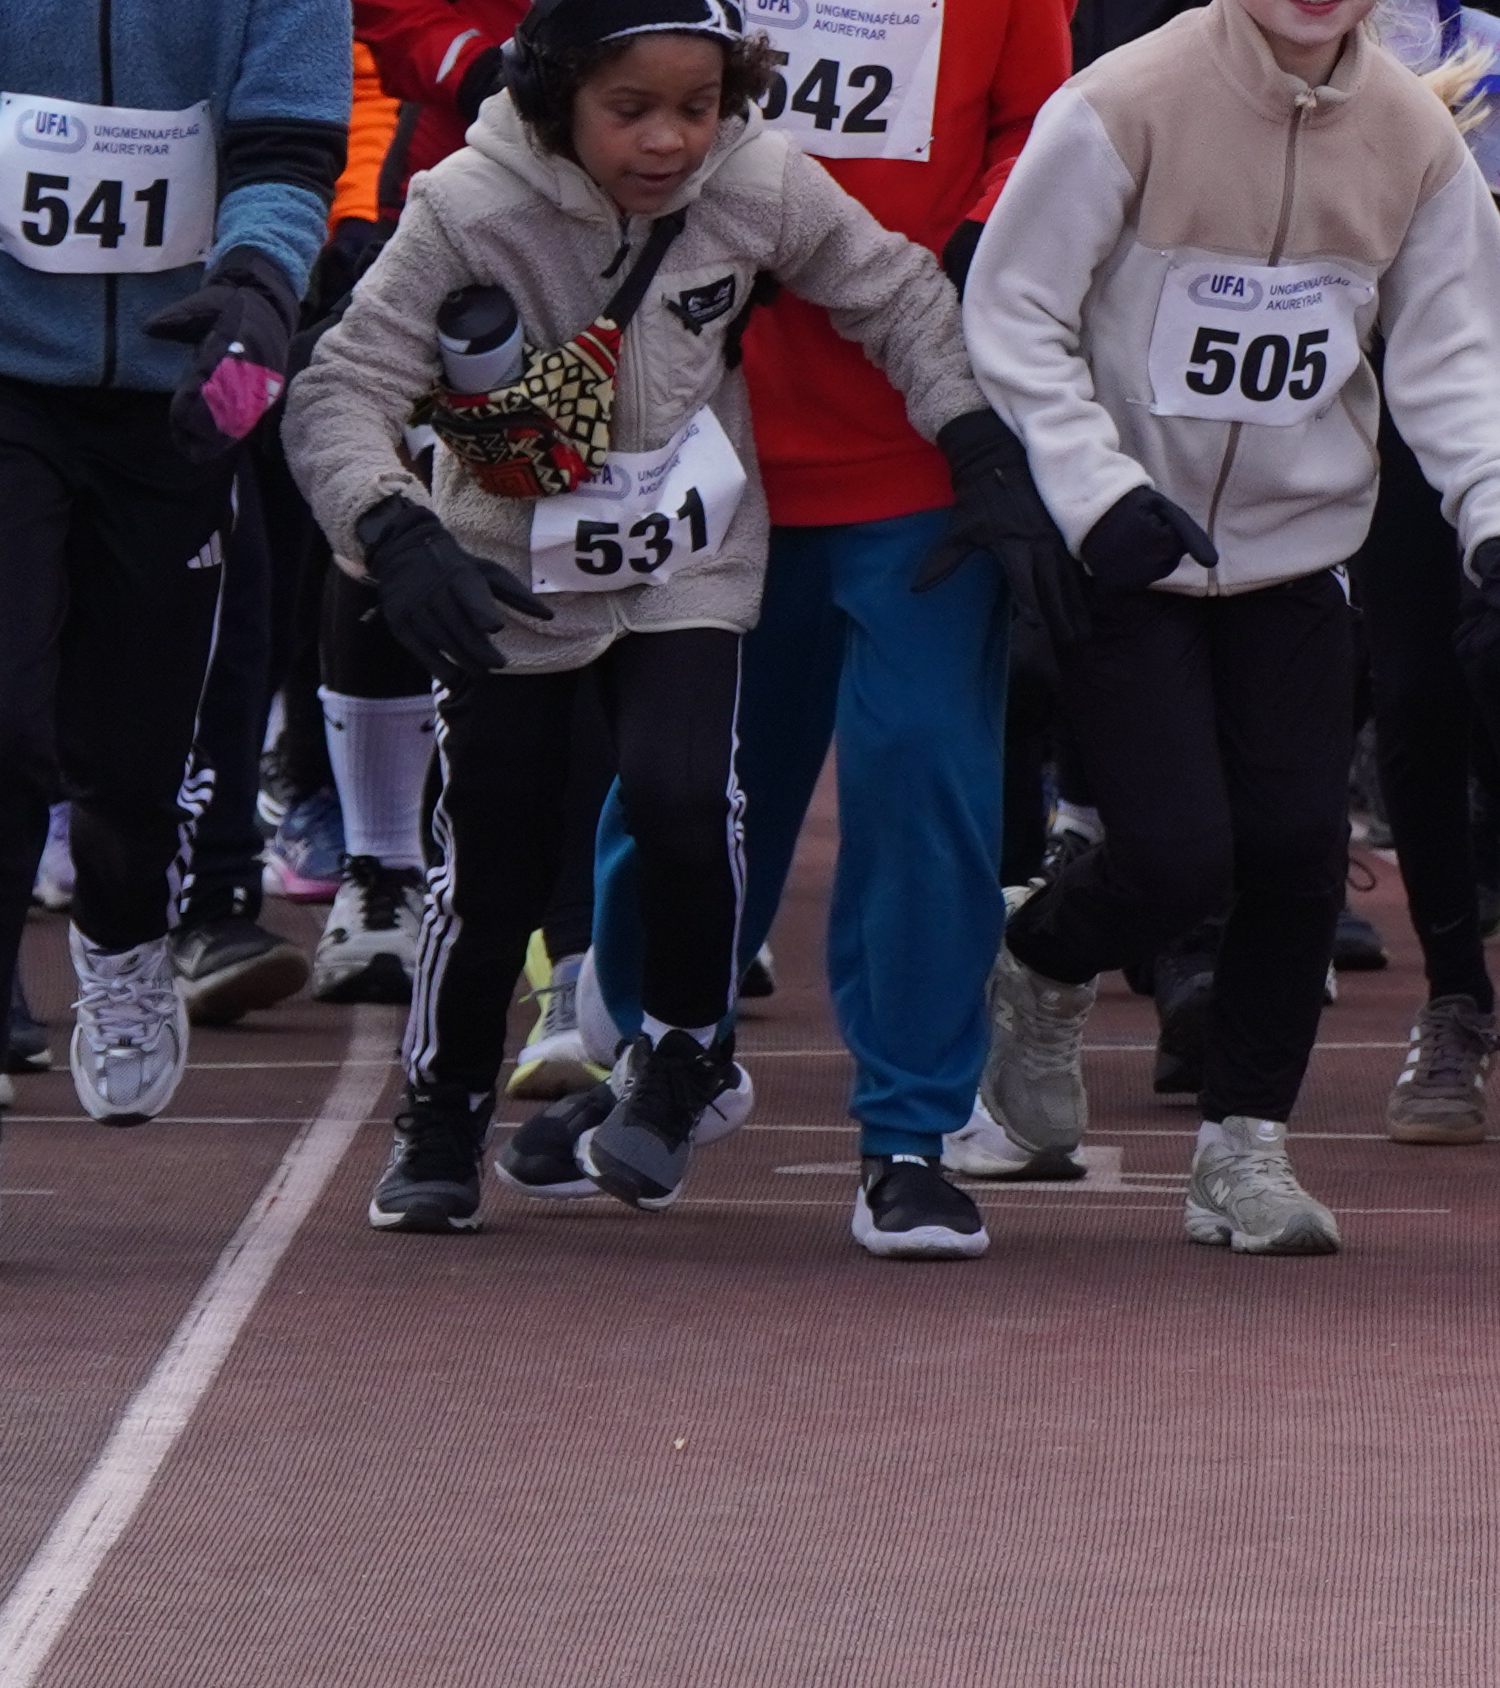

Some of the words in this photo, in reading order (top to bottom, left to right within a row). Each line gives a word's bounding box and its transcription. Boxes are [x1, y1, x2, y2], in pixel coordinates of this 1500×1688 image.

[815, 2, 920, 25] UNGMENNAFÉLAG
[813, 18, 887, 41] AKUREYRAR
[35, 111, 68, 137] UFA
[93, 122, 200, 140] UNGMENNAFÉLAG
[92, 143, 170, 155] AKUREYRAR
[21, 171, 169, 249] 541
[1210, 274, 1244, 297] UFA
[1266, 291, 1323, 311] AKUREYRAR
[1185, 326, 1330, 402] 505
[574, 486, 708, 576] 531
